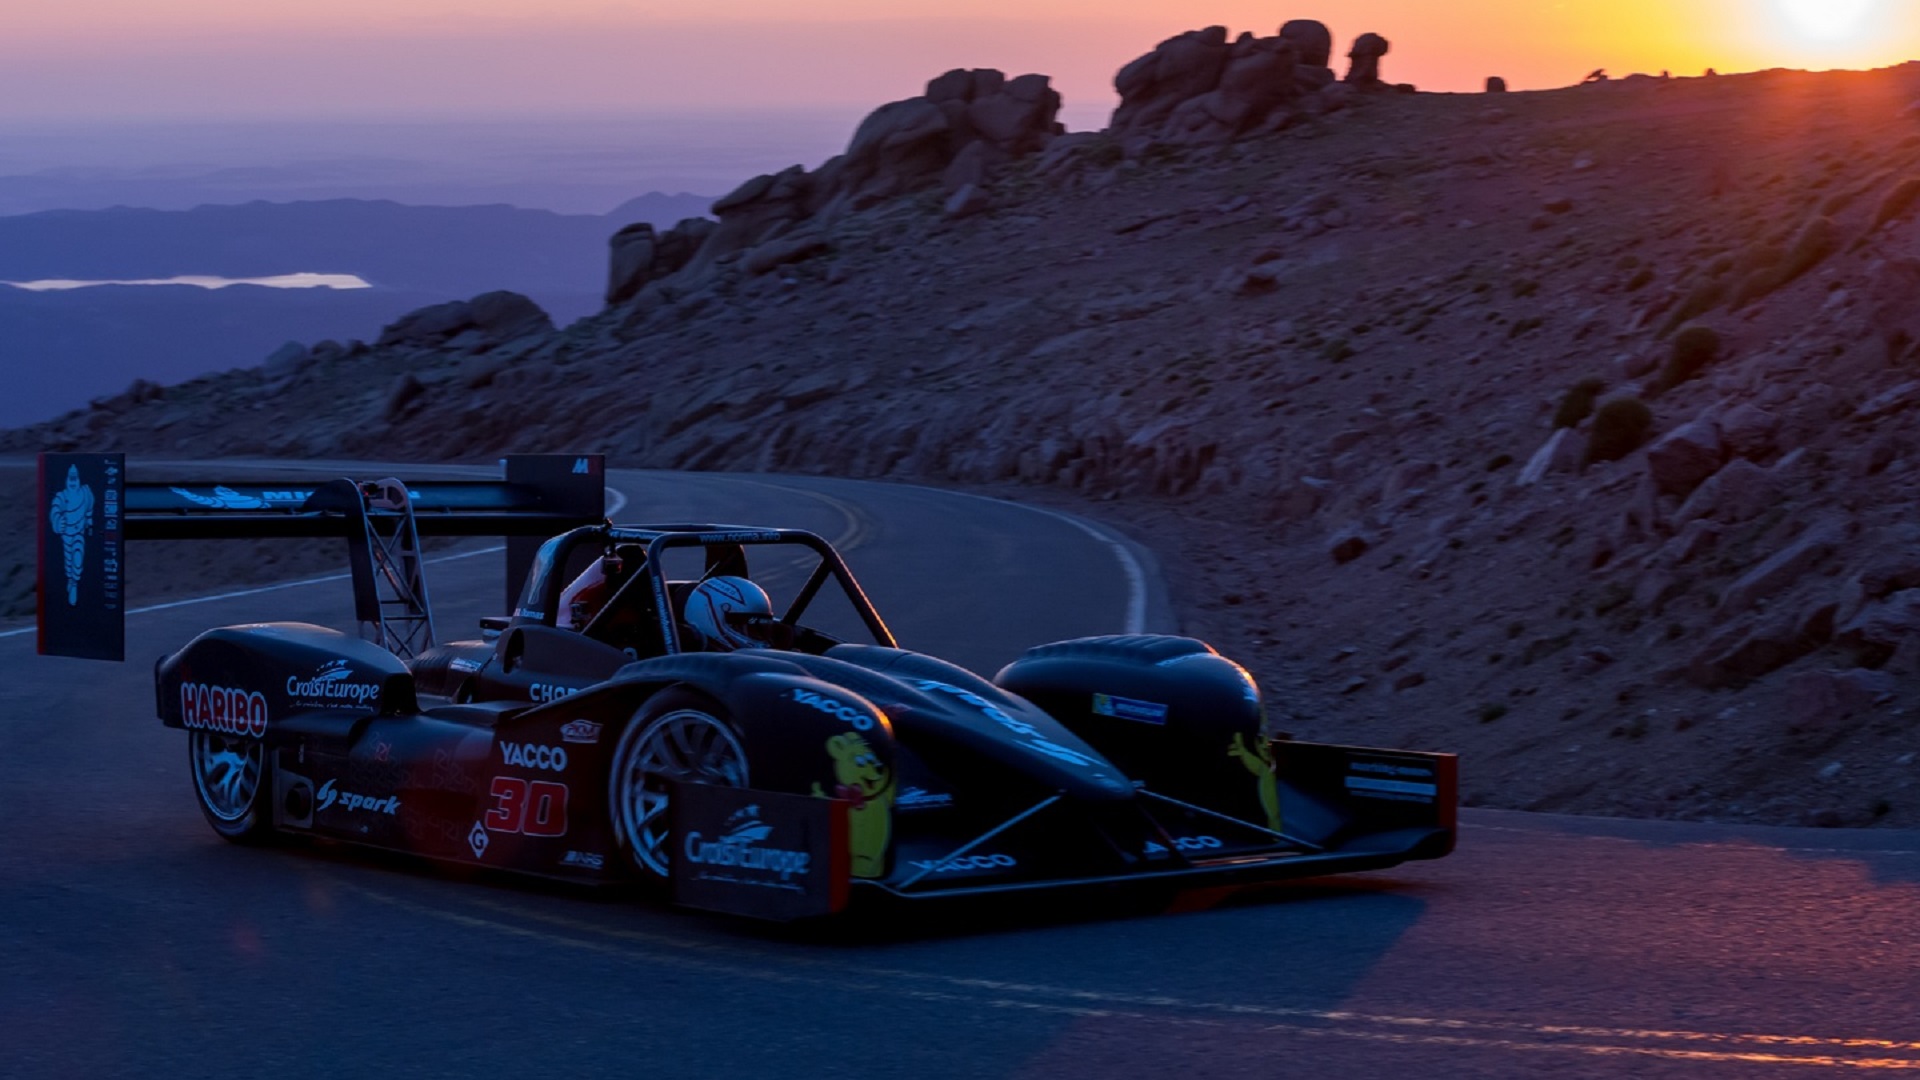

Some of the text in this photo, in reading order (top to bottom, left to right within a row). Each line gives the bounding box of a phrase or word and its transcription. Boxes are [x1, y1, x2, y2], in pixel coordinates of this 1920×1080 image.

[286, 675, 380, 704] CroisiEurope
[180, 681, 268, 738] HARIBO
[792, 688, 874, 731] YACCO
[499, 740, 568, 772] YACCO
[338, 791, 401, 815] spark
[485, 776, 570, 837] 30
